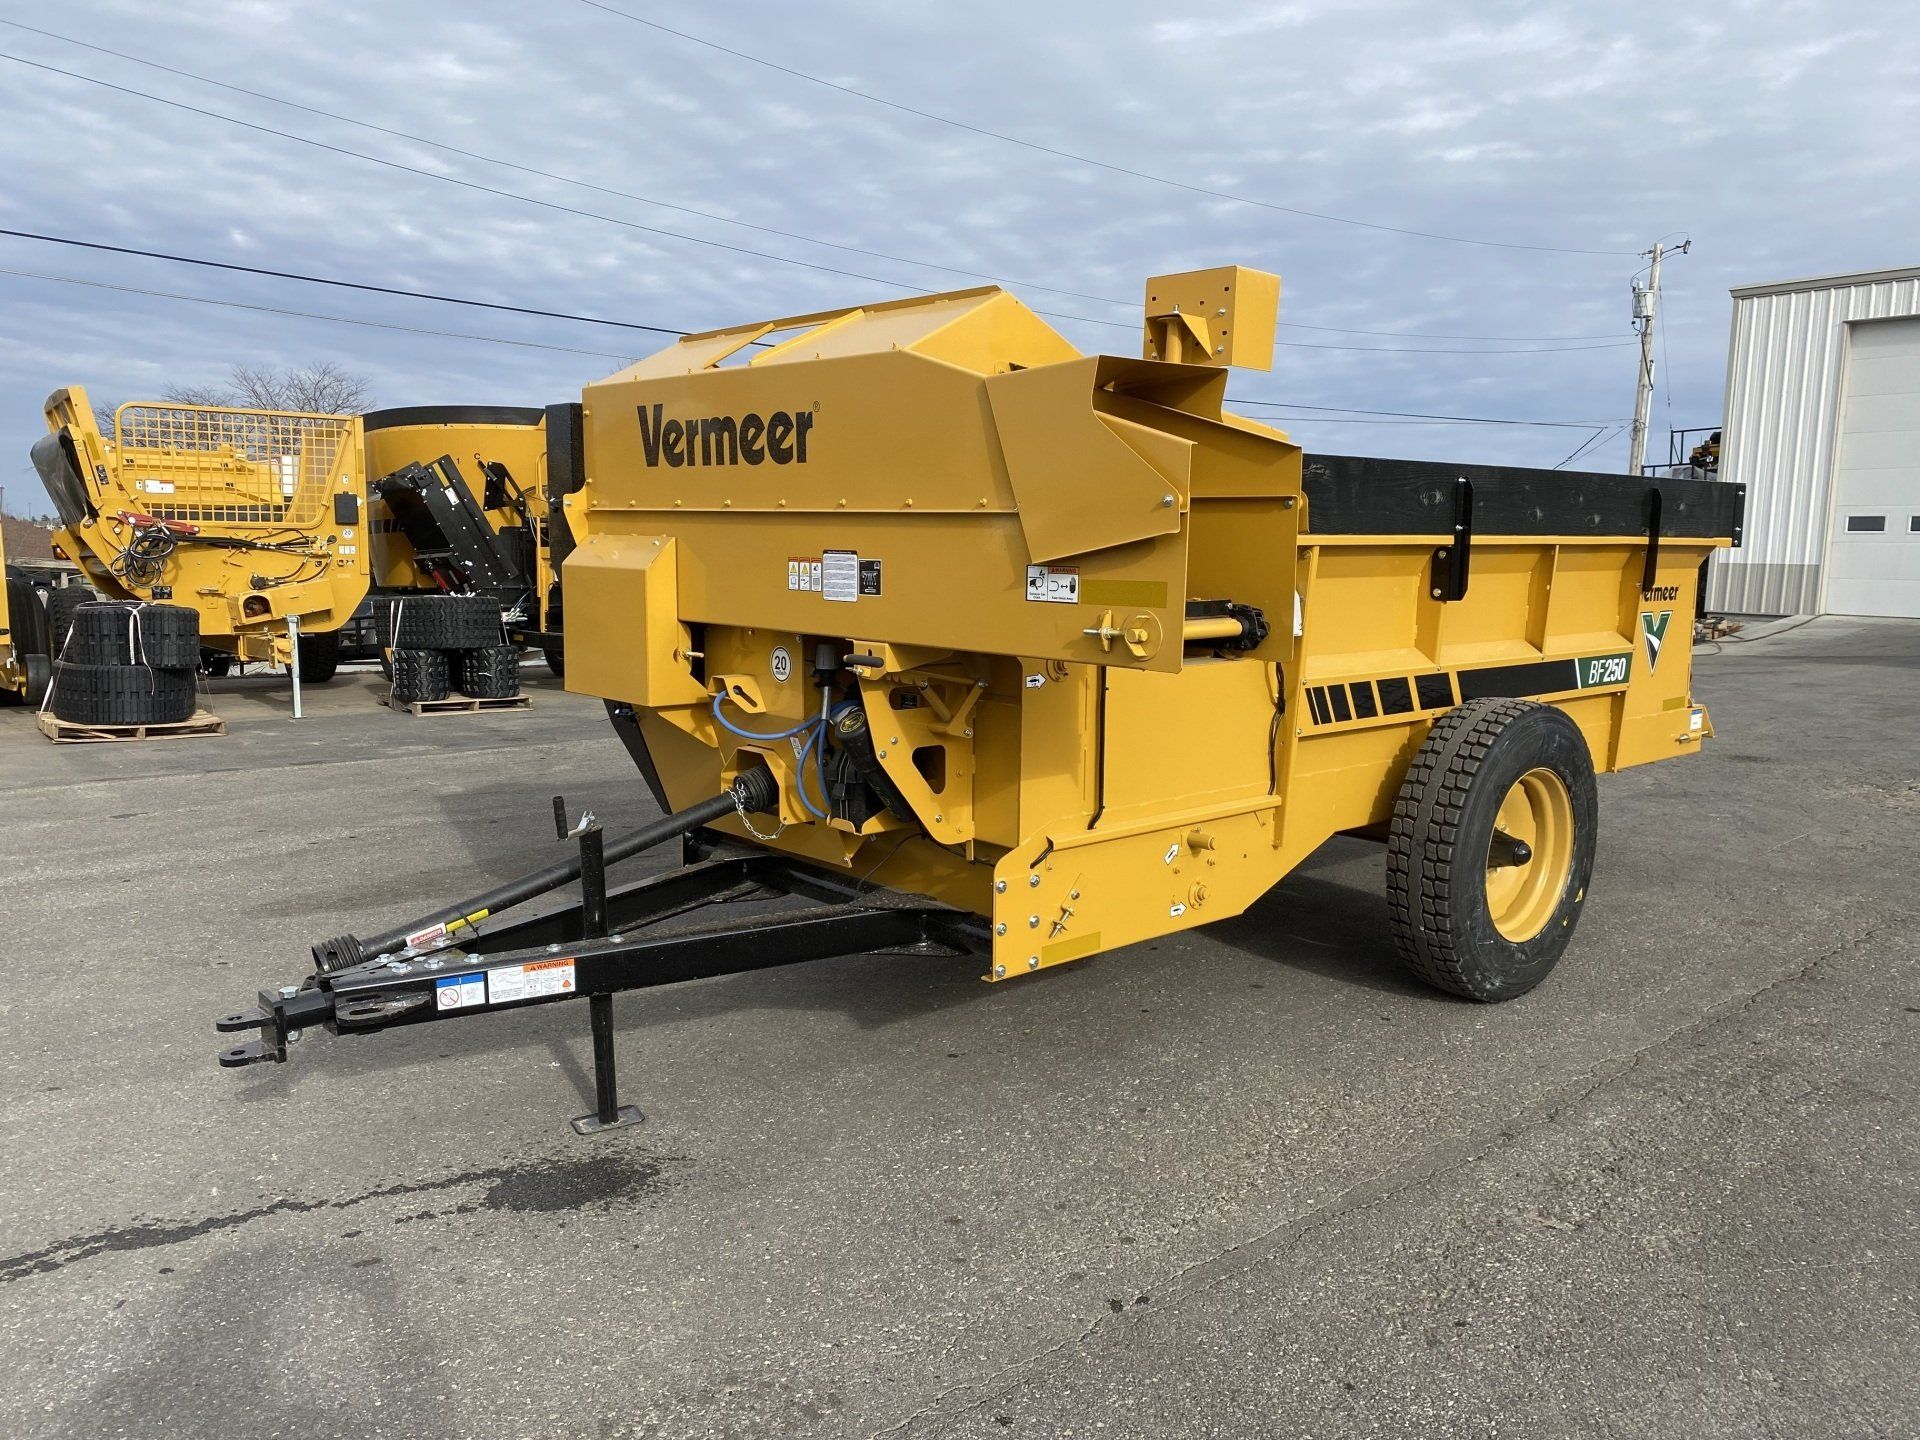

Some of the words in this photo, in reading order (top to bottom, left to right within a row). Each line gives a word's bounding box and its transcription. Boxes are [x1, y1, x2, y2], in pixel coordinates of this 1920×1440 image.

[637, 402, 813, 468] Vermeer
[1642, 586, 1679, 602] ermeer
[775, 655, 786, 670] 20
[1588, 657, 1627, 685] BF250
[537, 960, 569, 970] WARNING
